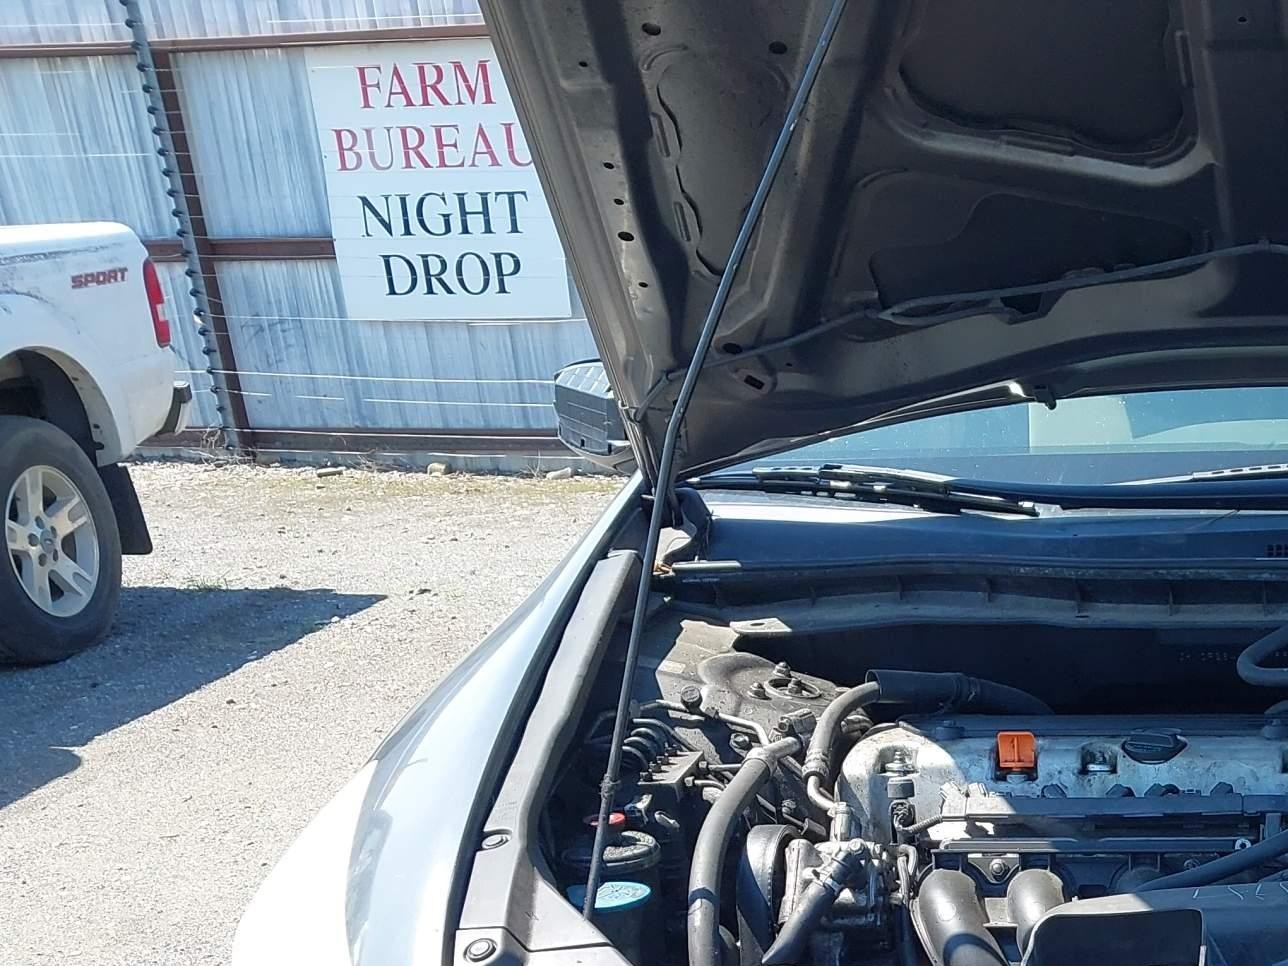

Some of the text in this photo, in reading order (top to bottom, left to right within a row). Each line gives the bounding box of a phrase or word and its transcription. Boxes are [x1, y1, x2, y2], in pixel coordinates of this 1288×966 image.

[355, 60, 496, 109] FARM
[331, 122, 534, 172] BUREAU
[357, 191, 529, 238] NIGHT
[70, 266, 129, 290] SPORT
[379, 251, 522, 296] DROP
